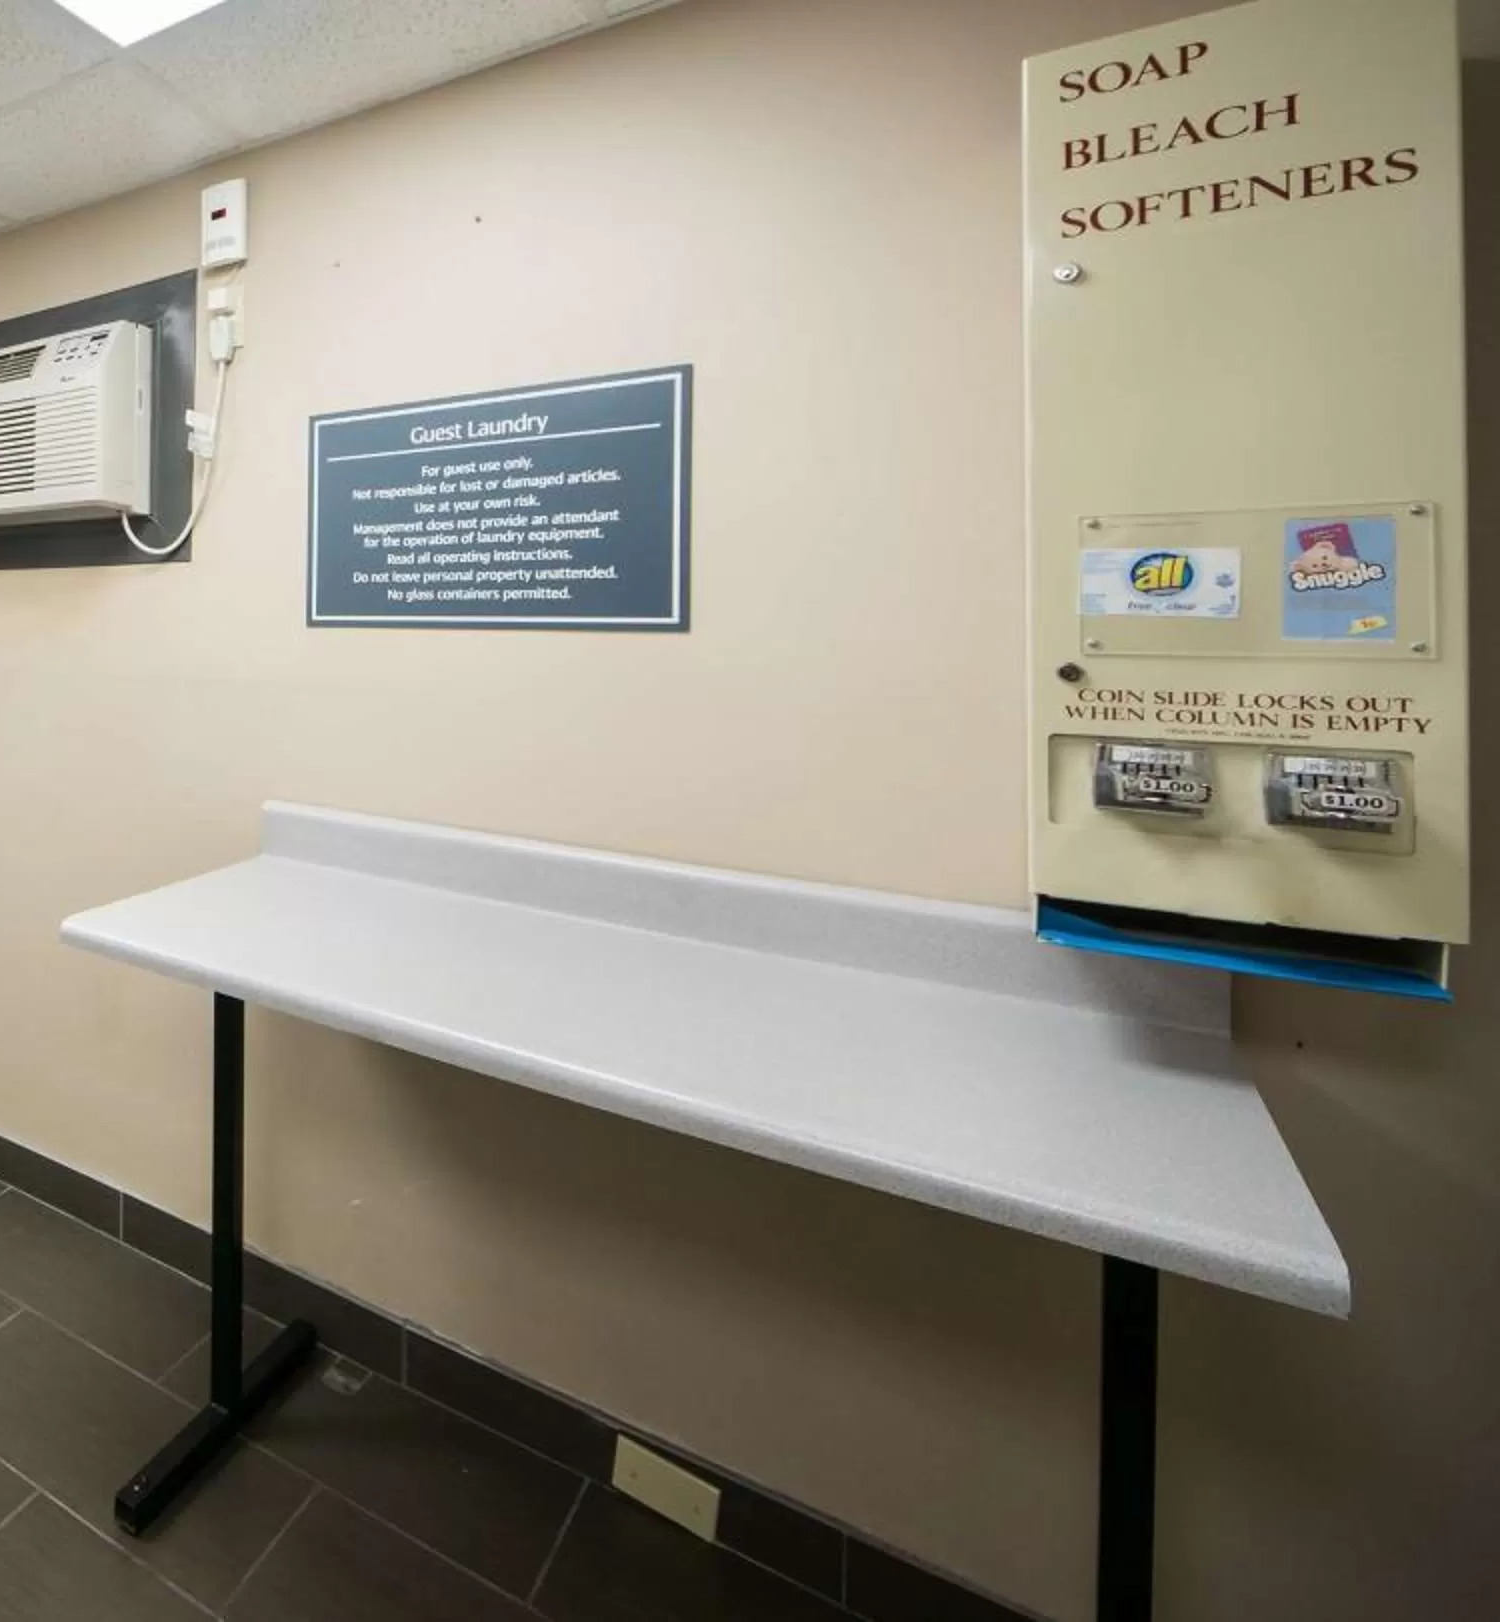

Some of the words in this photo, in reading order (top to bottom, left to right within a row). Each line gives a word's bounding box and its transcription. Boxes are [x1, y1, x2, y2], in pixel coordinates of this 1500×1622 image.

[1058, 40, 1209, 102] SOAP
[1062, 92, 1301, 171] BLEACH
[1060, 147, 1420, 239] SOFTENERS
[410, 423, 462, 444] Guest
[467, 412, 548, 438] Laundry
[421, 465, 440, 477] For
[443, 462, 476, 477] guest
[479, 461, 500, 473] use
[503, 456, 534, 472] only.
[352, 488, 372, 500] Not
[374, 484, 437, 500] responsible
[439, 481, 456, 493] for
[460, 480, 483, 492] lost
[485, 480, 500, 490] or
[502, 475, 564, 489] damaged
[567, 468, 621, 484] articles.
[413, 502, 435, 514] Use
[438, 501, 451, 513] at
[453, 499, 480, 514] your
[483, 498, 511, 509] own
[513, 493, 541, 508] risk.
[353, 521, 424, 535] Management
[426, 519, 455, 531] does
[457, 518, 478, 528] not
[480, 513, 528, 530] provide
[530, 514, 549, 525] an
[551, 509, 620, 524] attendant
[363, 537, 380, 548] for
[382, 536, 401, 548] the
[402, 534, 459, 548] operation
[461, 532, 475, 545] of
[477, 530, 525, 544] laundry
[527, 527, 605, 543] equipment.
[387, 553, 415, 565] Read
[417, 552, 431, 564] all
[433, 550, 491, 566] operating
[493, 549, 574, 562] instructions.
[353, 571, 369, 583] Do
[371, 571, 390, 583] not
[391, 570, 421, 583] leave
[422, 570, 474, 584] personal
[476, 570, 533, 584] property
[535, 566, 620, 580] unattended.
[1133, 555, 1188, 591] all
[1290, 561, 1386, 591] Snuggle
[387, 589, 403, 601] No
[405, 588, 435, 603] glass
[437, 588, 501, 601] containers
[503, 587, 573, 603] permitted.
[1078, 687, 1145, 704] COIN
[1153, 691, 1226, 707] SLIDE
[1238, 693, 1335, 711] LOCKS
[1346, 696, 1413, 714] OUT
[1065, 705, 1145, 722] WHEN
[1155, 709, 1280, 728] COLUMN
[1291, 713, 1315, 729] IS
[1327, 715, 1432, 735] EMPTY
[1142, 779, 1195, 794] $1.00
[1323, 794, 1384, 810] $1.00
